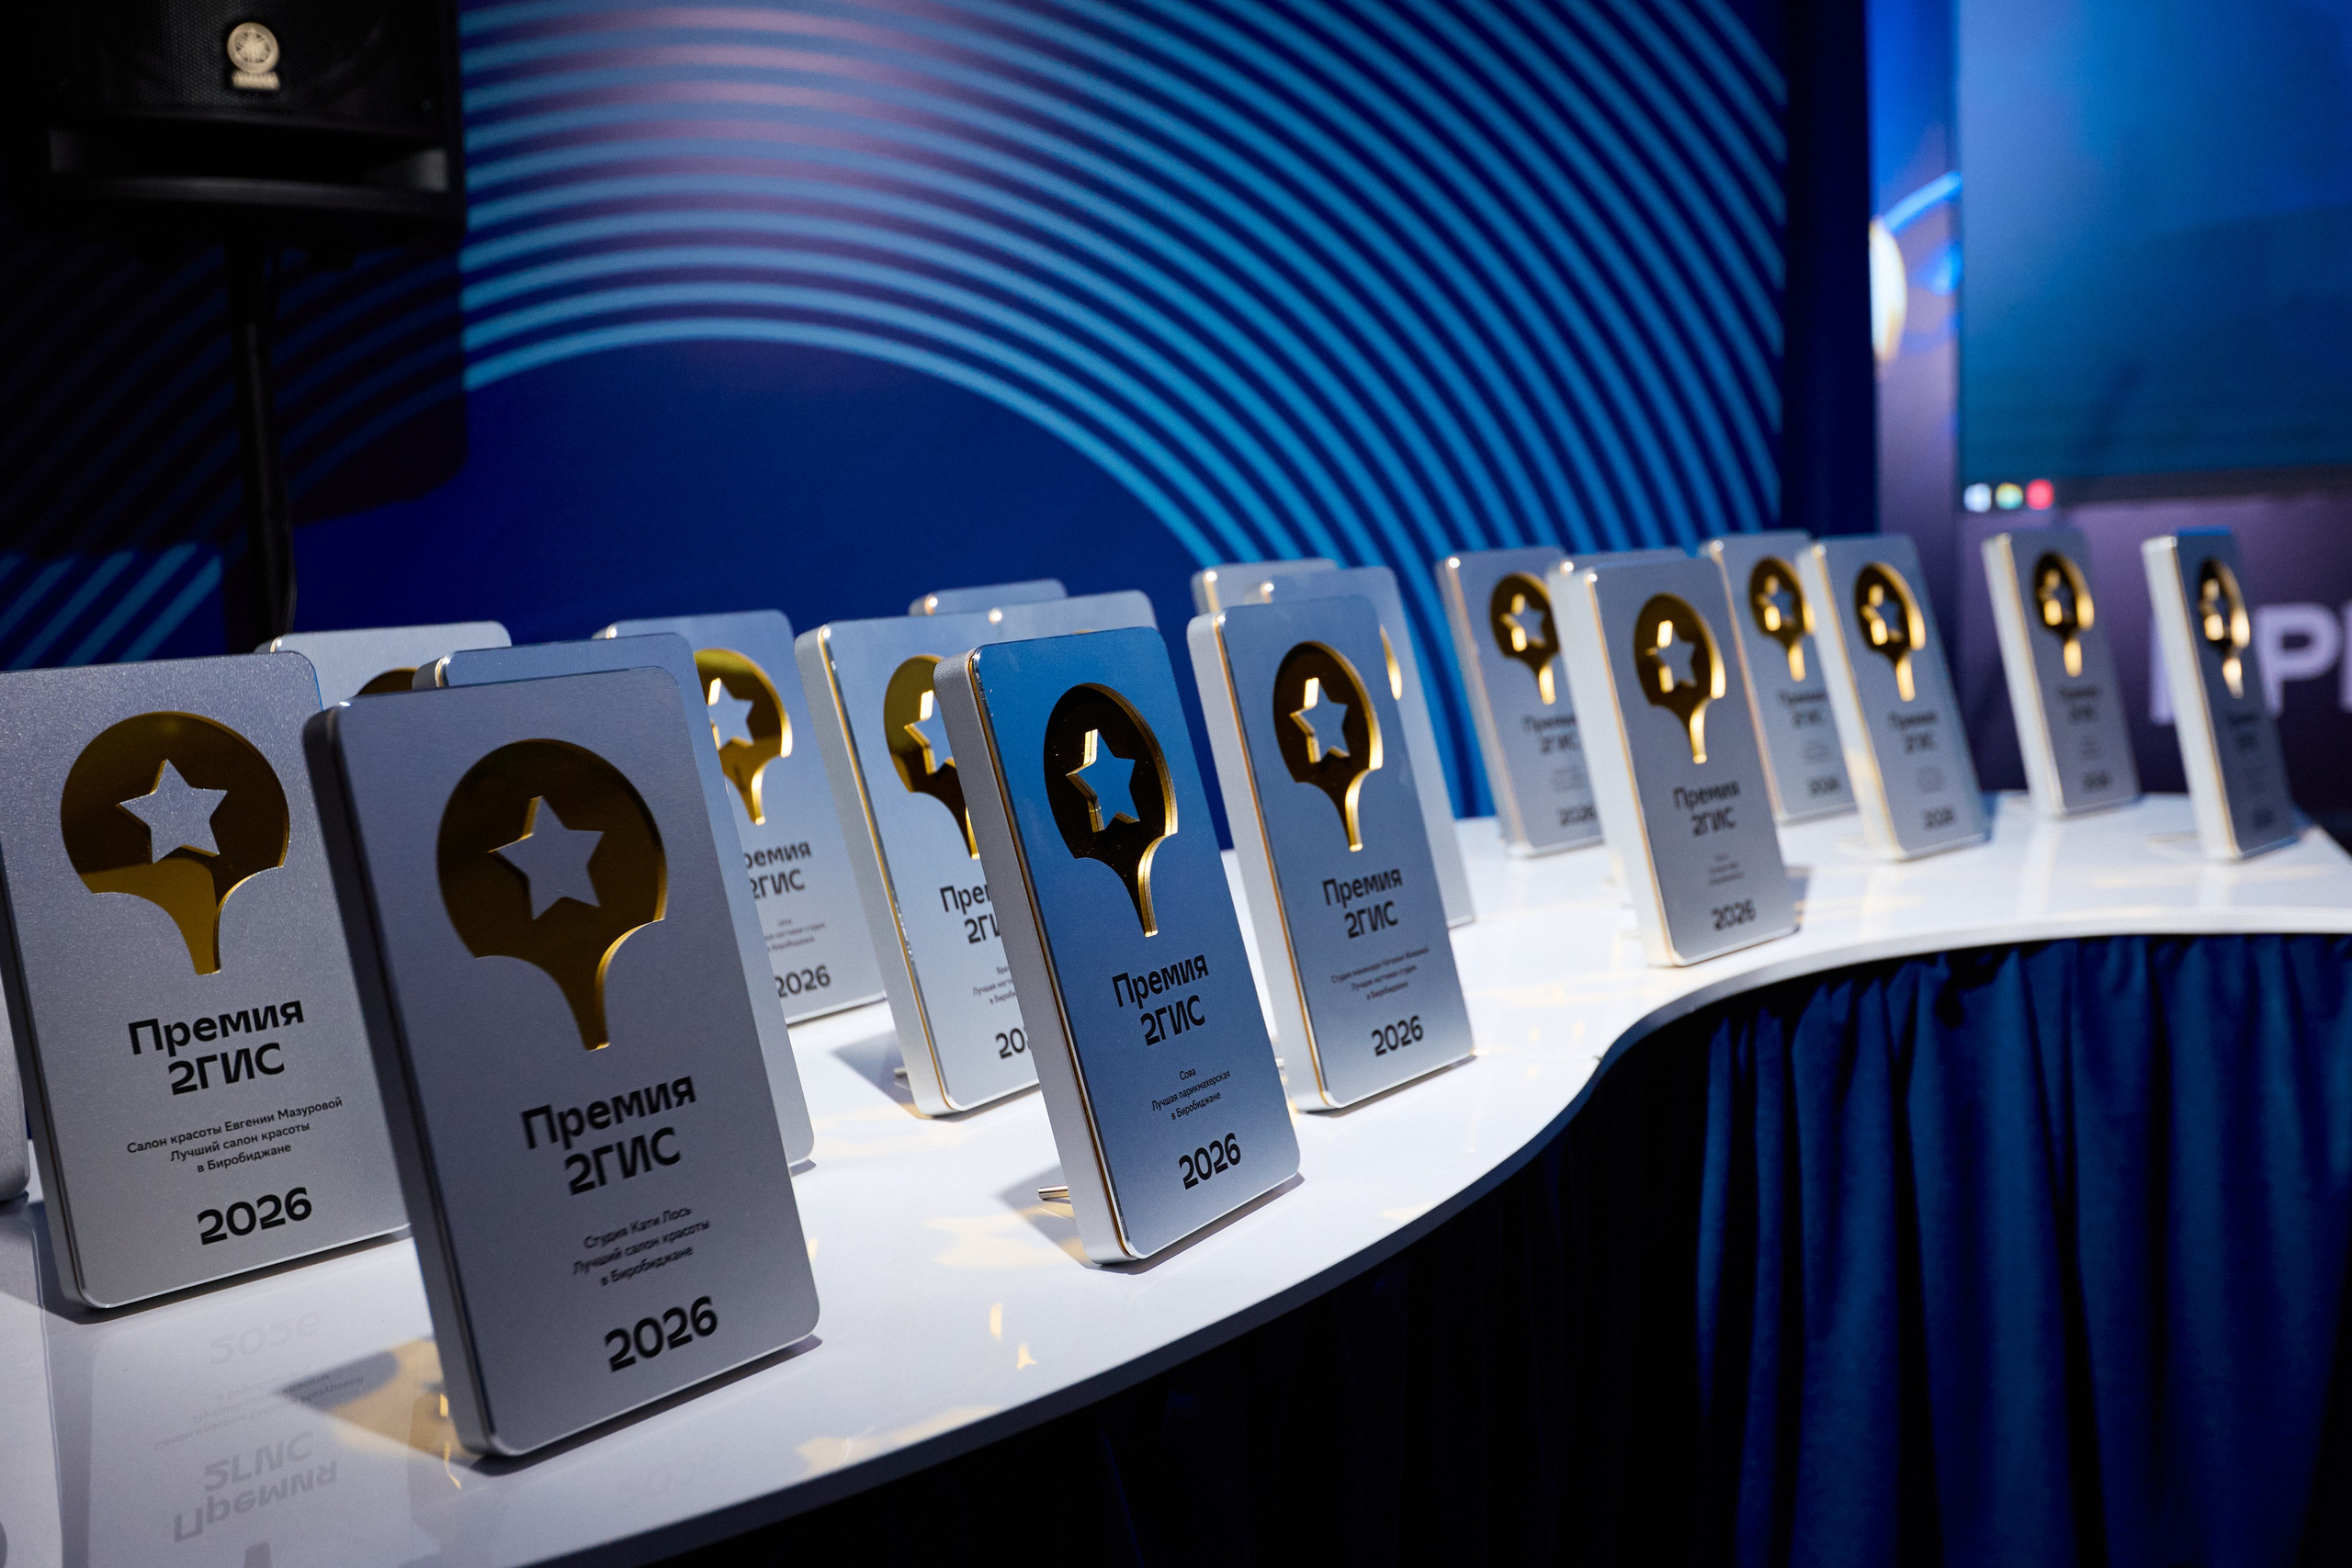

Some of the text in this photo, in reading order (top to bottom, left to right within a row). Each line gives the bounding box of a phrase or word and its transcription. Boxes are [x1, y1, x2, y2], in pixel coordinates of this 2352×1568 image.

[1672, 781, 1740, 810] Премия
[1690, 806, 1736, 837] 2ГИС
[940, 884, 991, 915] Пре
[1322, 869, 1402, 908] Премия
[1343, 900, 1398, 939] 2ГИС
[1711, 897, 1758, 931] 2026
[775, 965, 831, 998] 2026
[1112, 954, 1209, 1010] Премия
[128, 1000, 304, 1057] Премия
[1140, 995, 1205, 1046] 2ГИС
[1371, 1015, 1424, 1057] 2026
[996, 1027, 1031, 1059] 20
[167, 1043, 285, 1096] 2ГИС
[1180, 1068, 1196, 1080] Сова
[1151, 1071, 1230, 1111] Лучшая парикмахерская
[1176, 1092, 1221, 1117] Биробиджане
[127, 1097, 343, 1154] Салон красоты Евгении Мазуровой
[521, 1076, 697, 1150] Премия
[170, 1122, 311, 1162] Лучший салон красоты
[197, 1144, 291, 1173] в Биробиджане
[564, 1126, 682, 1195] 2ГИС
[1179, 1133, 1240, 1190] 2026
[197, 1187, 311, 1246] 2026
[629, 1217, 661, 1235] Кати
[572, 1220, 710, 1275] Лучший салон красоты
[610, 1247, 694, 1283] Биробиджане
[605, 1295, 718, 1373] 2026
